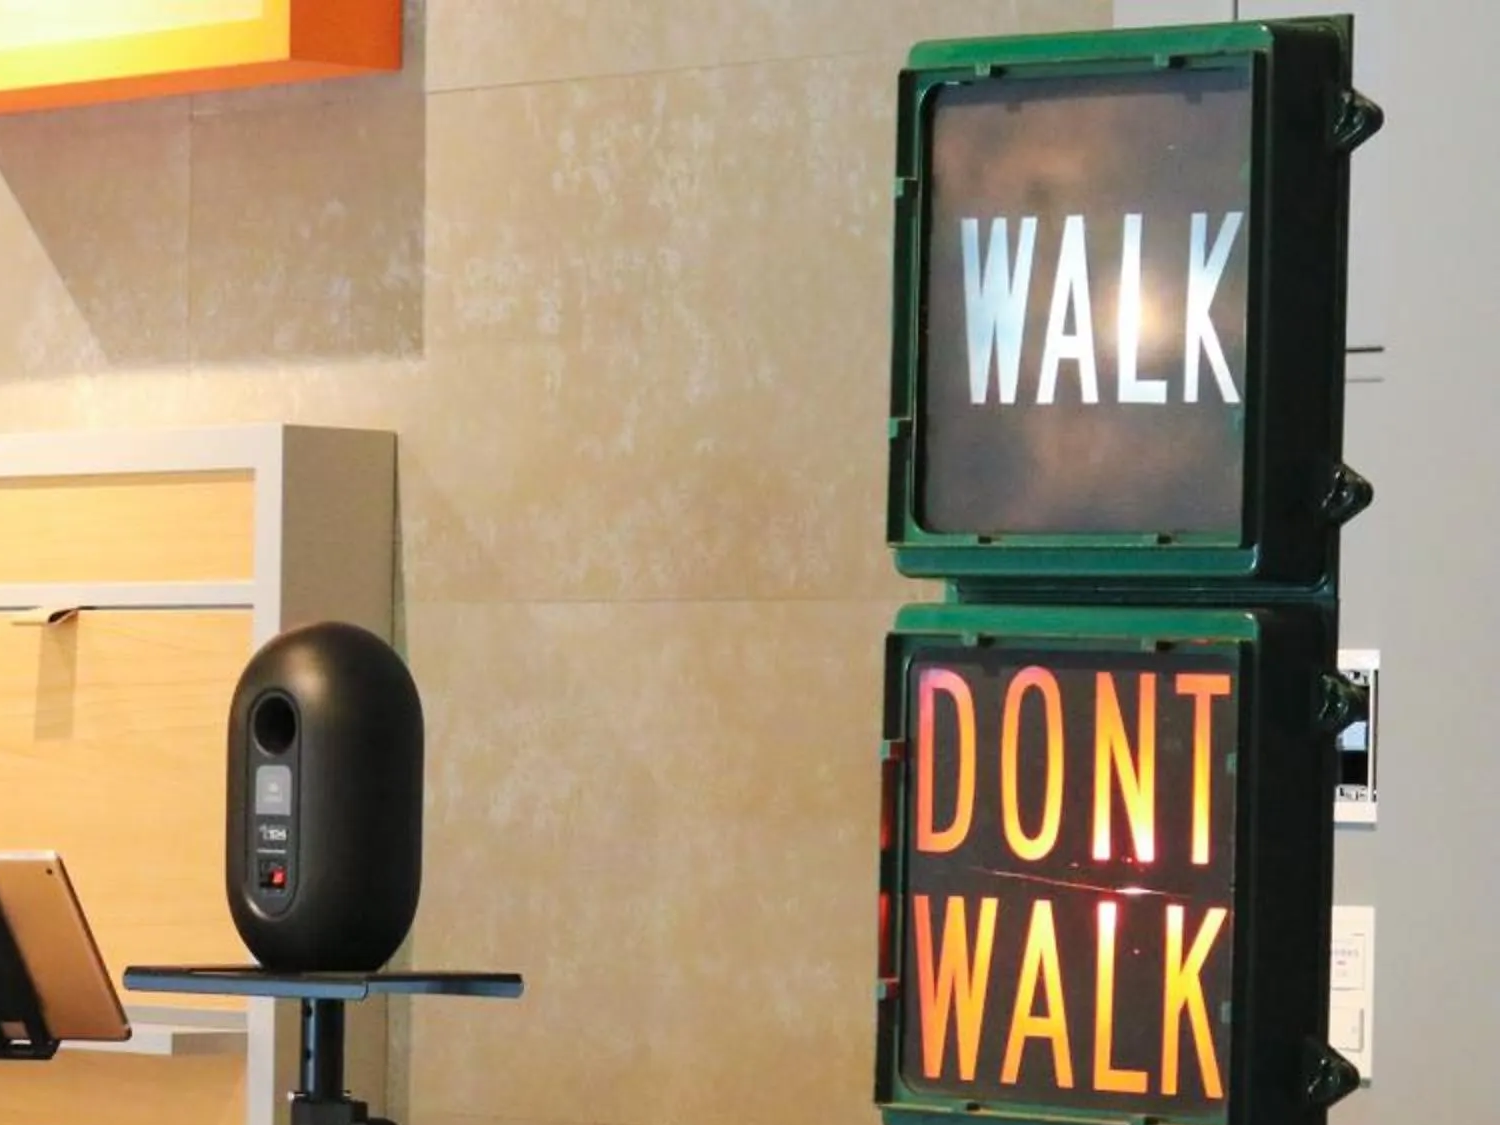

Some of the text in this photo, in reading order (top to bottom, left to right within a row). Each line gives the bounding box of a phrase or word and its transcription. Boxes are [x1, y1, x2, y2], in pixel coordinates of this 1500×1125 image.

[960, 210, 1244, 405] WALK
[916, 664, 1232, 865] DONT
[913, 894, 1228, 1099] WALK
